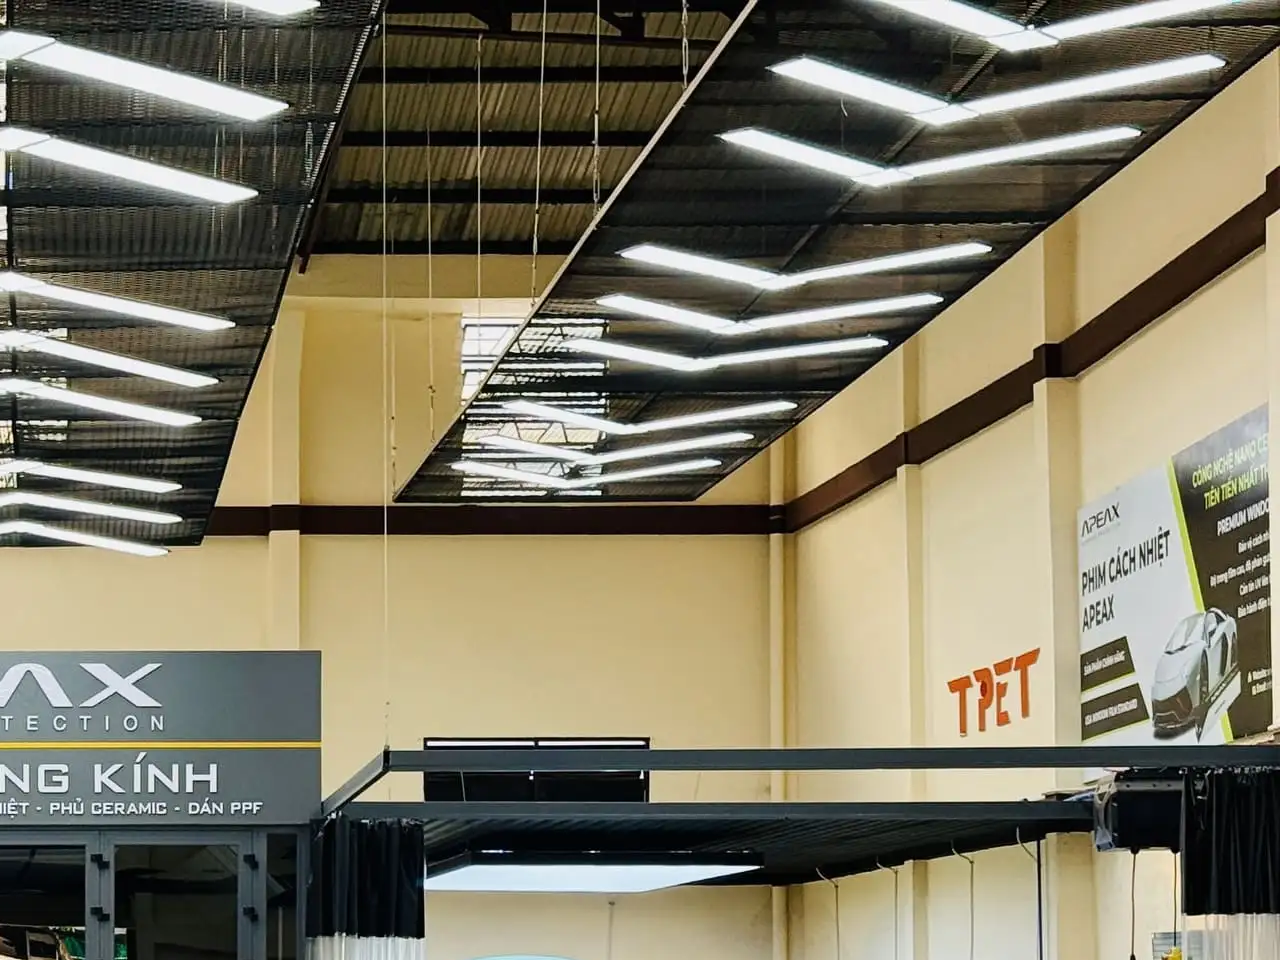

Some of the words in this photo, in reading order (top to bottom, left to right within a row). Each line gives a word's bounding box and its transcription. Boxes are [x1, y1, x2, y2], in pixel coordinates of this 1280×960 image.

[1081, 502, 1120, 537] APEAX
[1217, 509, 1246, 537] PREMIUM
[1082, 561, 1106, 597] PHIM
[1108, 546, 1136, 583] CÁCH
[1139, 526, 1170, 570] NHIỆT
[1082, 593, 1115, 632] APEAX
[947, 648, 1040, 737] TPET
[94, 752, 218, 794] KÍNH
[49, 798, 85, 815] PHỦ
[91, 802, 167, 815] CERAMIC
[188, 798, 224, 815] DÁN
[230, 802, 264, 815] PPF
